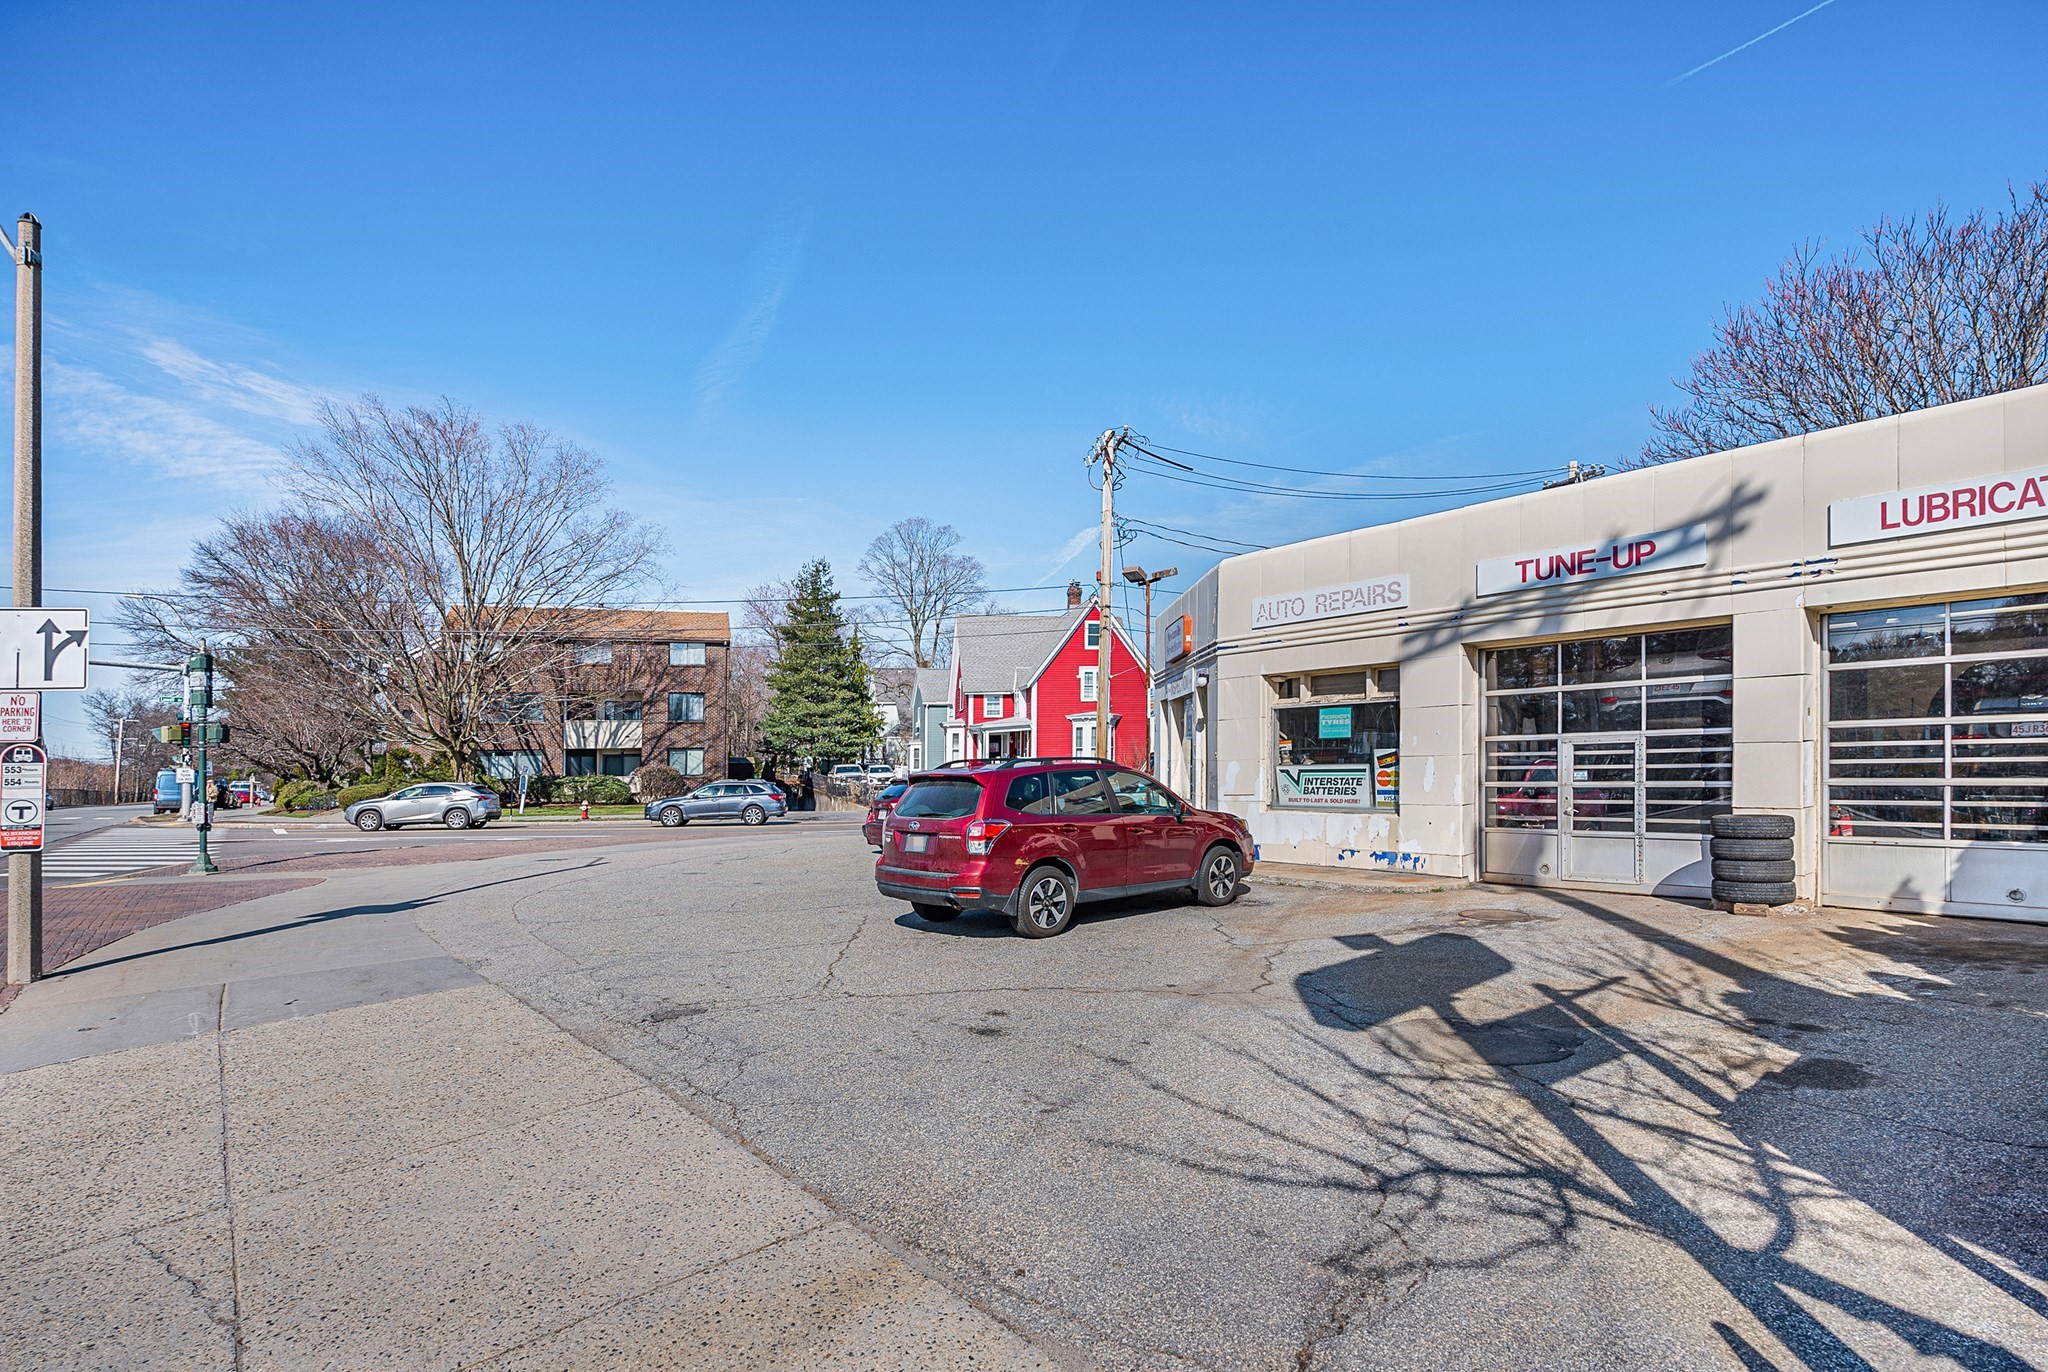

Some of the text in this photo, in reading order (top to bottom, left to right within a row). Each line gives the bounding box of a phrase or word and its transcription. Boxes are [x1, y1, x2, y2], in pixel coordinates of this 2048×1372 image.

[1514, 539, 1657, 584] TUNE-UP
[1256, 580, 1402, 623] AUTO REPAIRS
[10, 696, 26, 706] NO
[0, 707, 35, 717] PARKING
[2, 718, 32, 726] HERE TO
[2, 725, 31, 733] CORNER
[4, 766, 22, 774] 553
[4, 778, 21, 786] 554
[1304, 777, 1363, 786] INTERSTATE
[1303, 786, 1357, 796] BATTERIES
